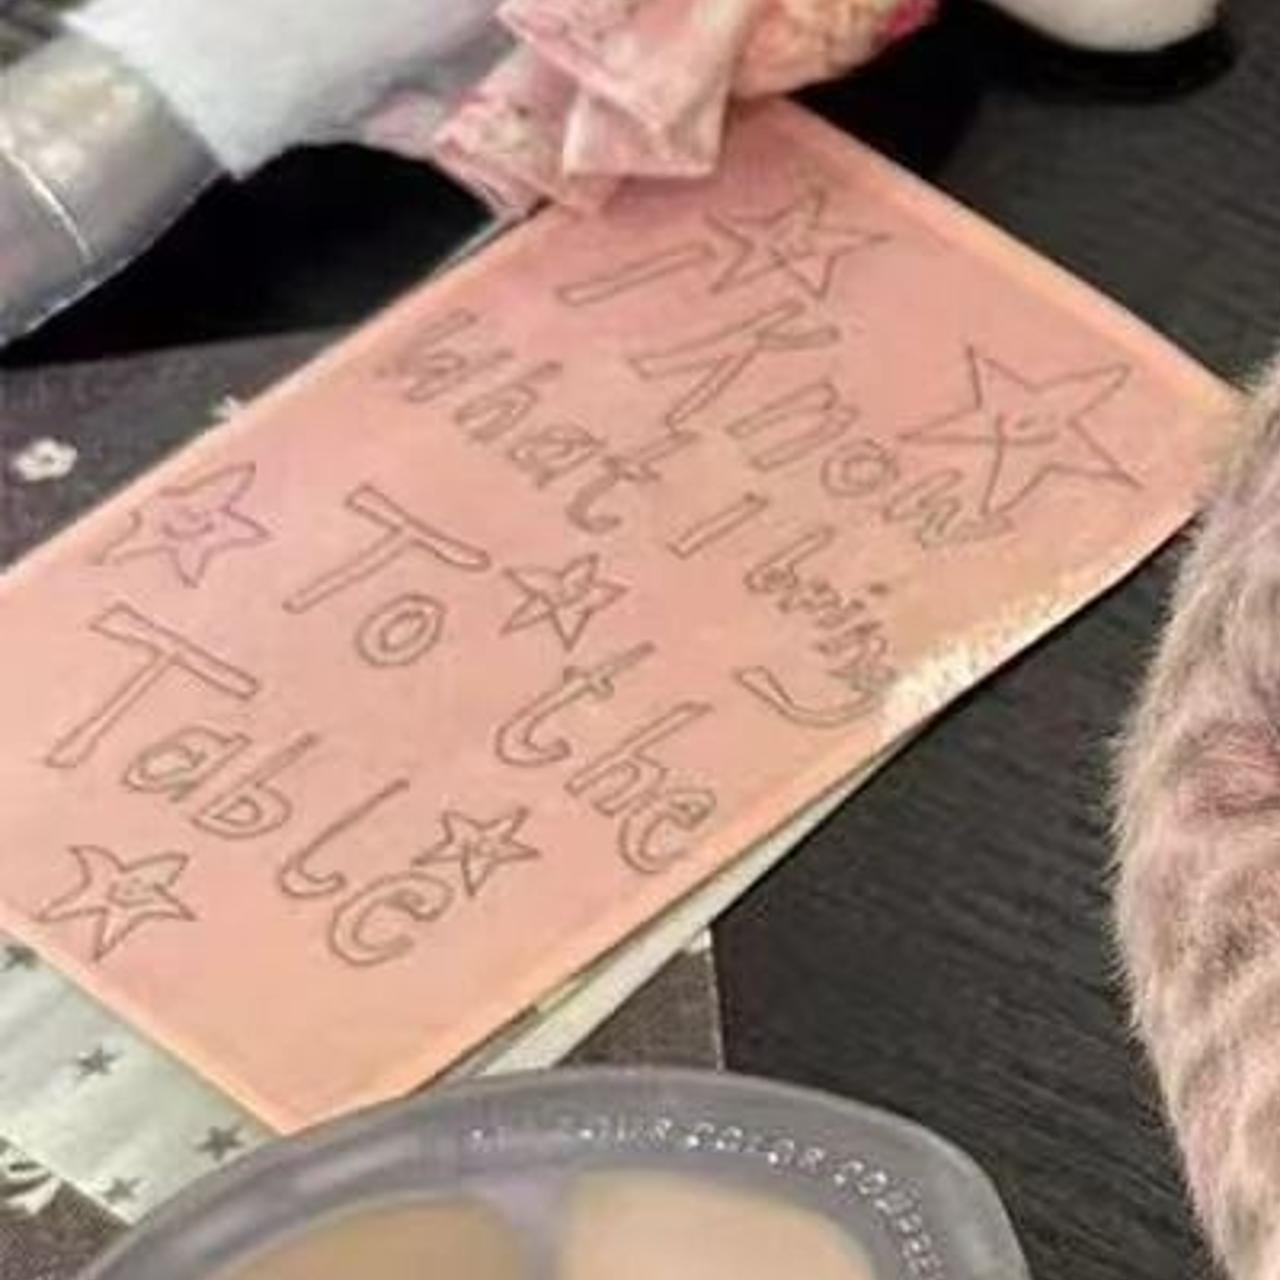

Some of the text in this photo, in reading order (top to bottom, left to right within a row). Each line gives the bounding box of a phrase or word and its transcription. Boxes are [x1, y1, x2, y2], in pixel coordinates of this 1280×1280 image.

[45, 602, 456, 967] Table
[282, 483, 719, 876] To the
